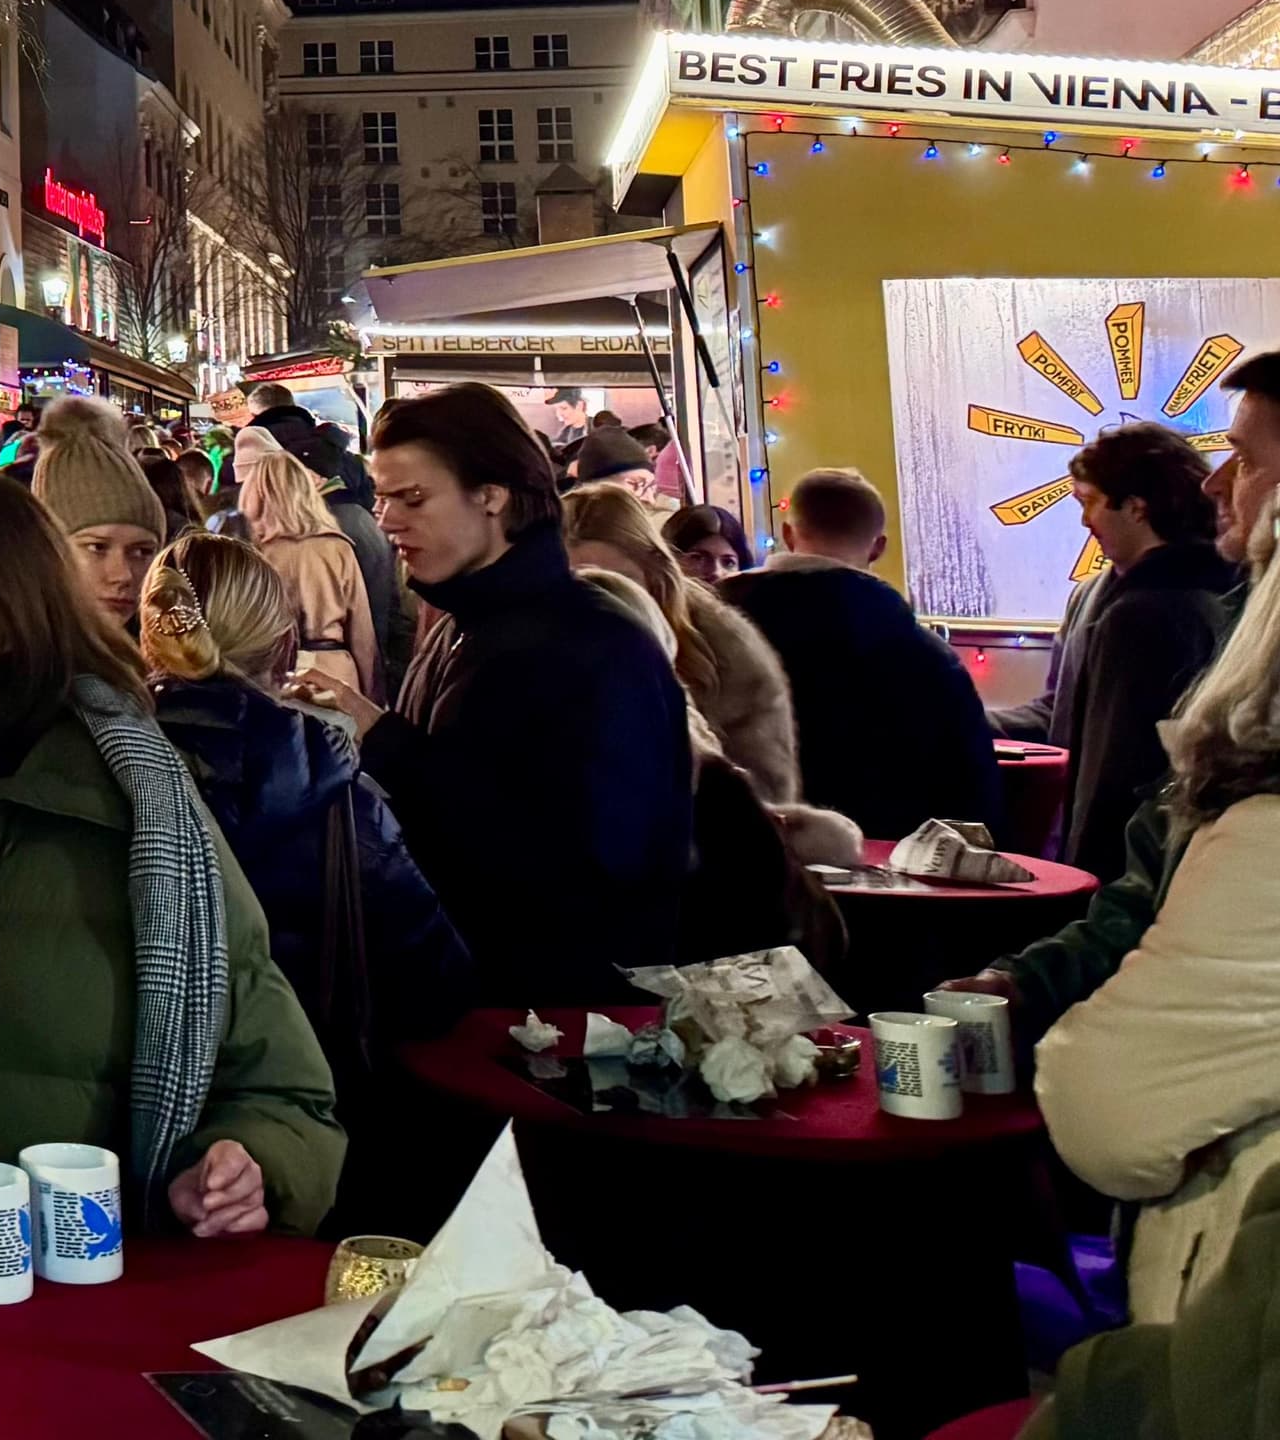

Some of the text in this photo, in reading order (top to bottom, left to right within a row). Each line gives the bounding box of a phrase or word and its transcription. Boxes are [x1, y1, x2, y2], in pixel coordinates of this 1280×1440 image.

[677, 49, 798, 87] BEST
[811, 57, 946, 99] FRIES
[963, 67, 1011, 104] IN
[1028, 71, 1218, 116] VIENNA
[382, 335, 555, 352] SPITTELBERGER
[1111, 321, 1134, 385] POMMES
[1185, 344, 1223, 387] FRIET
[992, 418, 1046, 440] FRYTKI
